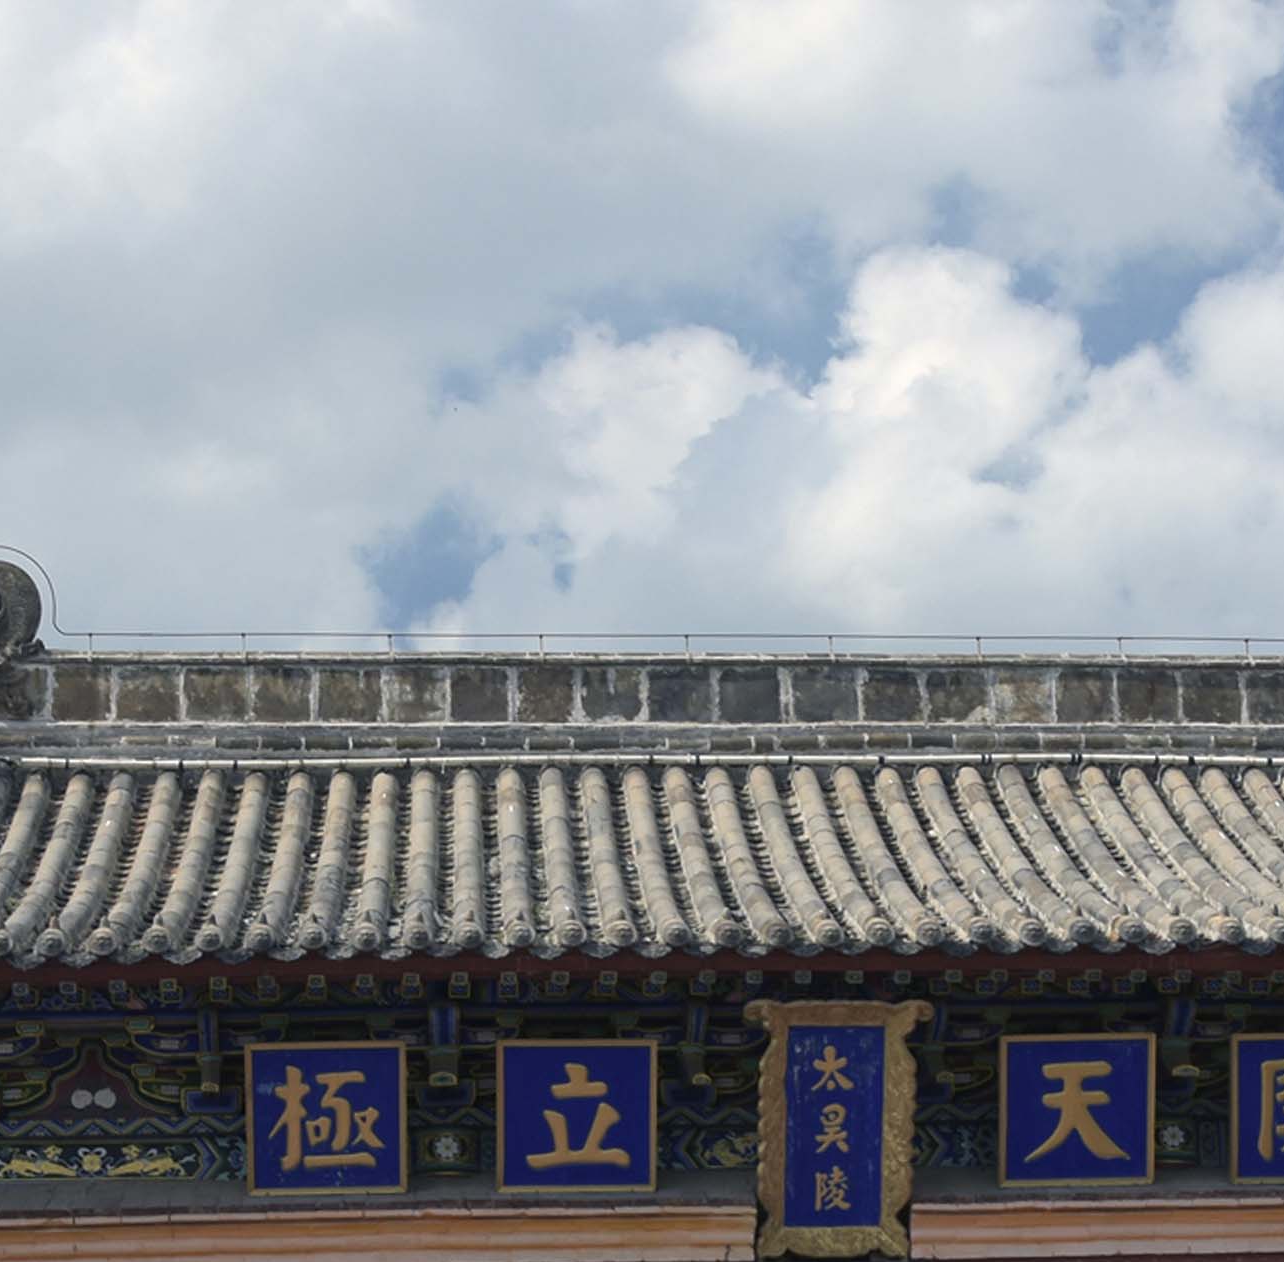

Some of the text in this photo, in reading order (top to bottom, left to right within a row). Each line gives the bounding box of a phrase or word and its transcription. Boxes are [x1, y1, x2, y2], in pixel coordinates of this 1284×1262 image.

[268, 1064, 386, 1171] 極
[525, 1062, 632, 1170] 立
[810, 1044, 855, 1212] 太昊陵
[1023, 1059, 1132, 1163] 天
